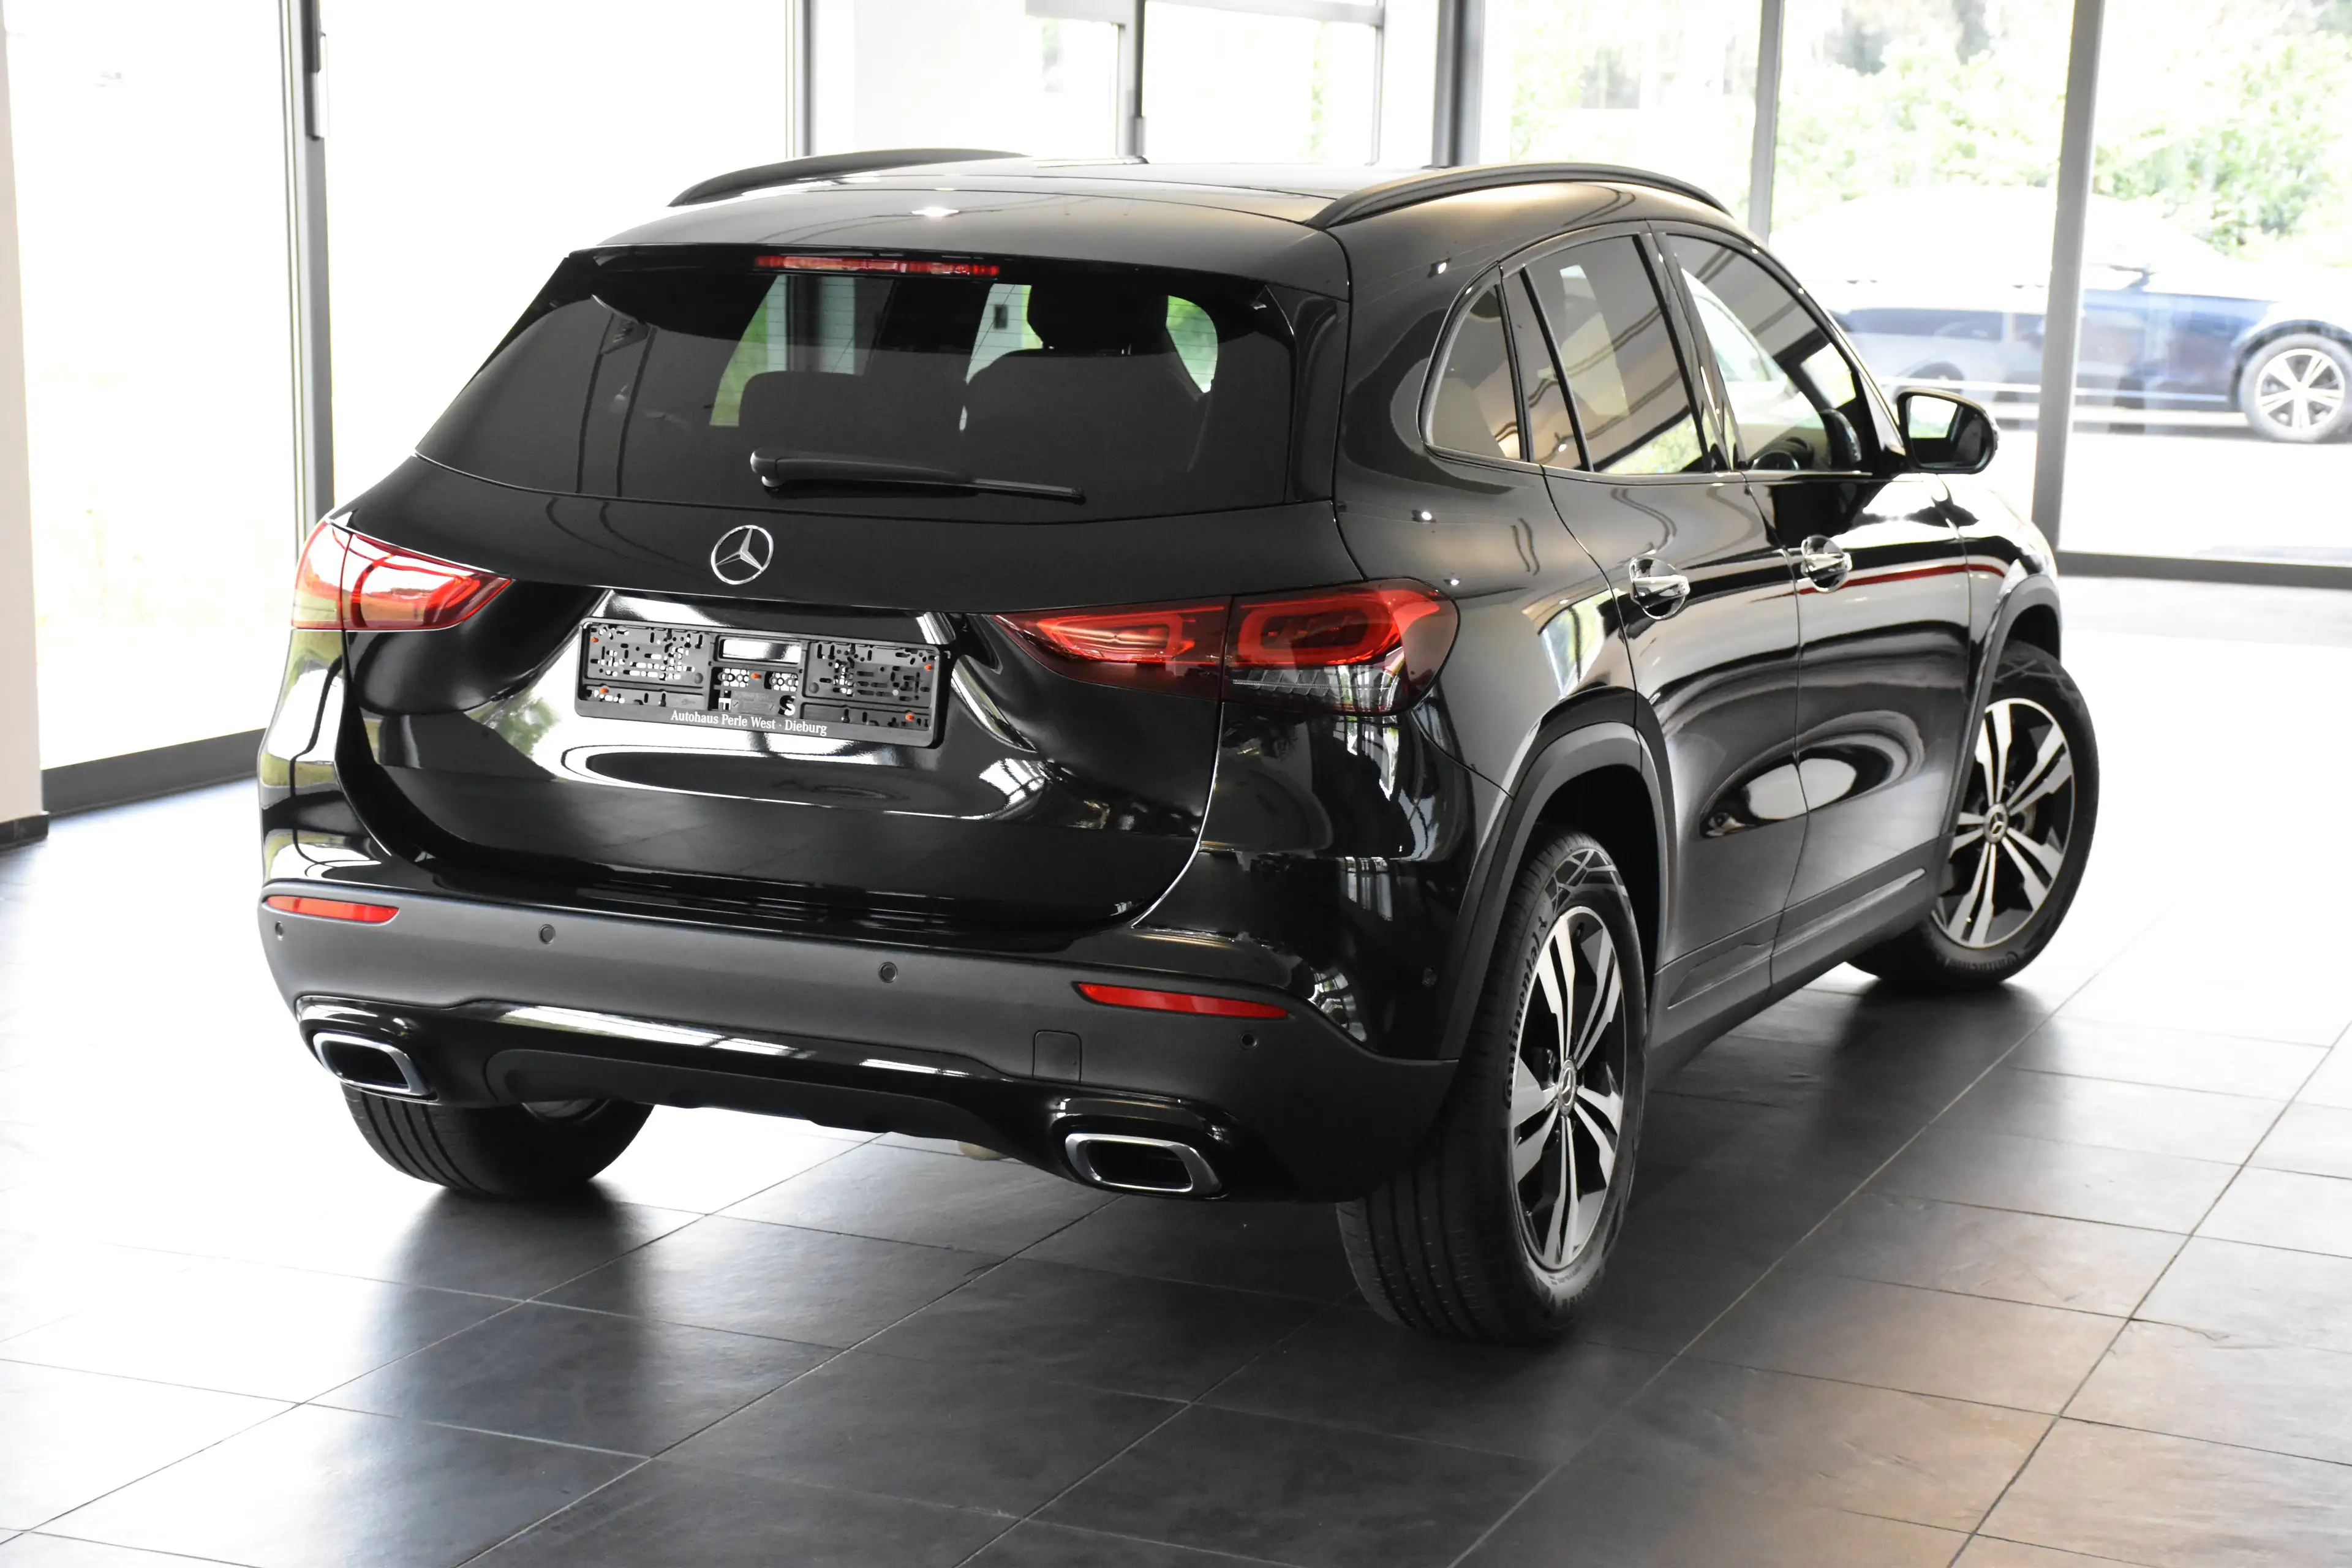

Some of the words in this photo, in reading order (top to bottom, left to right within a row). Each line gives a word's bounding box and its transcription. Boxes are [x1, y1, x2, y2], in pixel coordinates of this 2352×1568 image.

[671, 710, 718, 724] Autohaus
[722, 714, 747, 726] Perle
[751, 717, 775, 729] West
[785, 720, 827, 736] Dieburg
